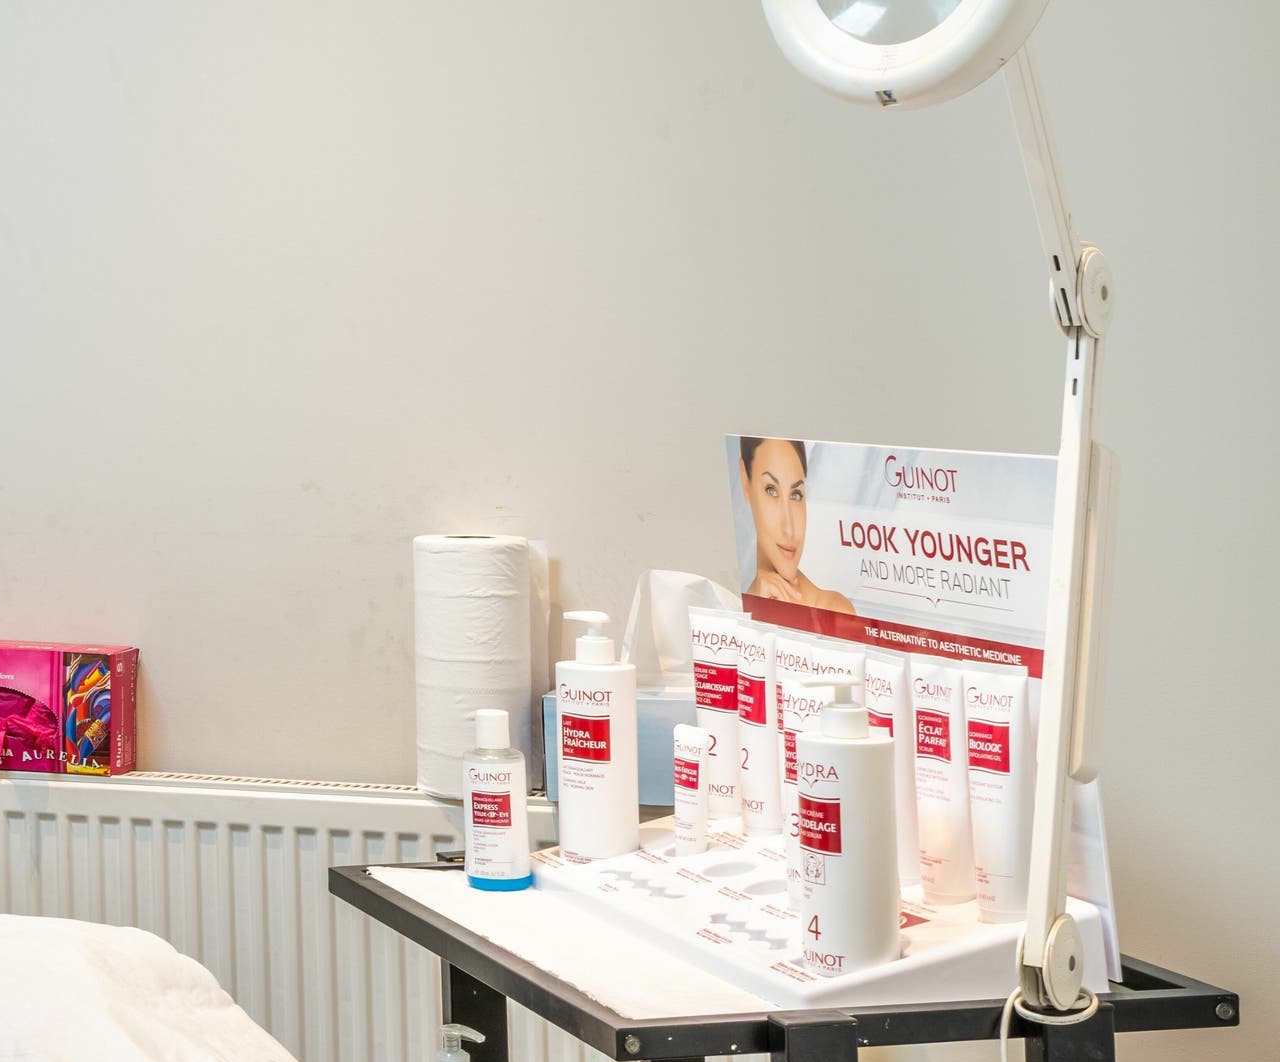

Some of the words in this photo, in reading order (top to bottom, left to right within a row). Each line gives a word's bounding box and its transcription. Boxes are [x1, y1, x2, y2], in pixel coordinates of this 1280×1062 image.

[884, 455, 958, 493] GUINOT
[896, 492, 925, 501] INSTITUT
[931, 496, 951, 504] PARIS
[838, 519, 899, 554] LOOK
[903, 527, 1031, 572] YOUNGER
[860, 559, 889, 580] AND
[892, 563, 936, 588] MORE
[940, 570, 1011, 599] RADIANT
[692, 629, 738, 648] HYDRA
[864, 626, 879, 638] THE
[879, 629, 927, 647] ALTERNATIVE
[927, 638, 938, 649] TO
[939, 640, 982, 658] AESTHETIC
[982, 649, 1022, 665] MEDICINE
[737, 640, 766, 659] HYDRA
[776, 650, 809, 670] HYDRA
[560, 683, 613, 703] GUINOT
[865, 674, 892, 694] HYDRA
[783, 694, 823, 713] HYDRA
[967, 686, 1014, 708] GUINOT
[563, 727, 590, 739] HYDRA
[919, 721, 943, 735] ÉCLAT
[563, 736, 607, 750] FRAÎCHEUR
[708, 734, 717, 756] 2
[969, 738, 1003, 753] BIOLOGIC
[22, 749, 102, 768] AURELIA
[741, 747, 749, 770] 2
[469, 768, 512, 782] GUINOT
[799, 760, 839, 780] YDRA
[708, 784, 736, 795] INOT
[473, 802, 499, 811] EXPRESS
[743, 799, 765, 810] NOT
[790, 813, 799, 837] 3
[807, 914, 822, 941] 4
